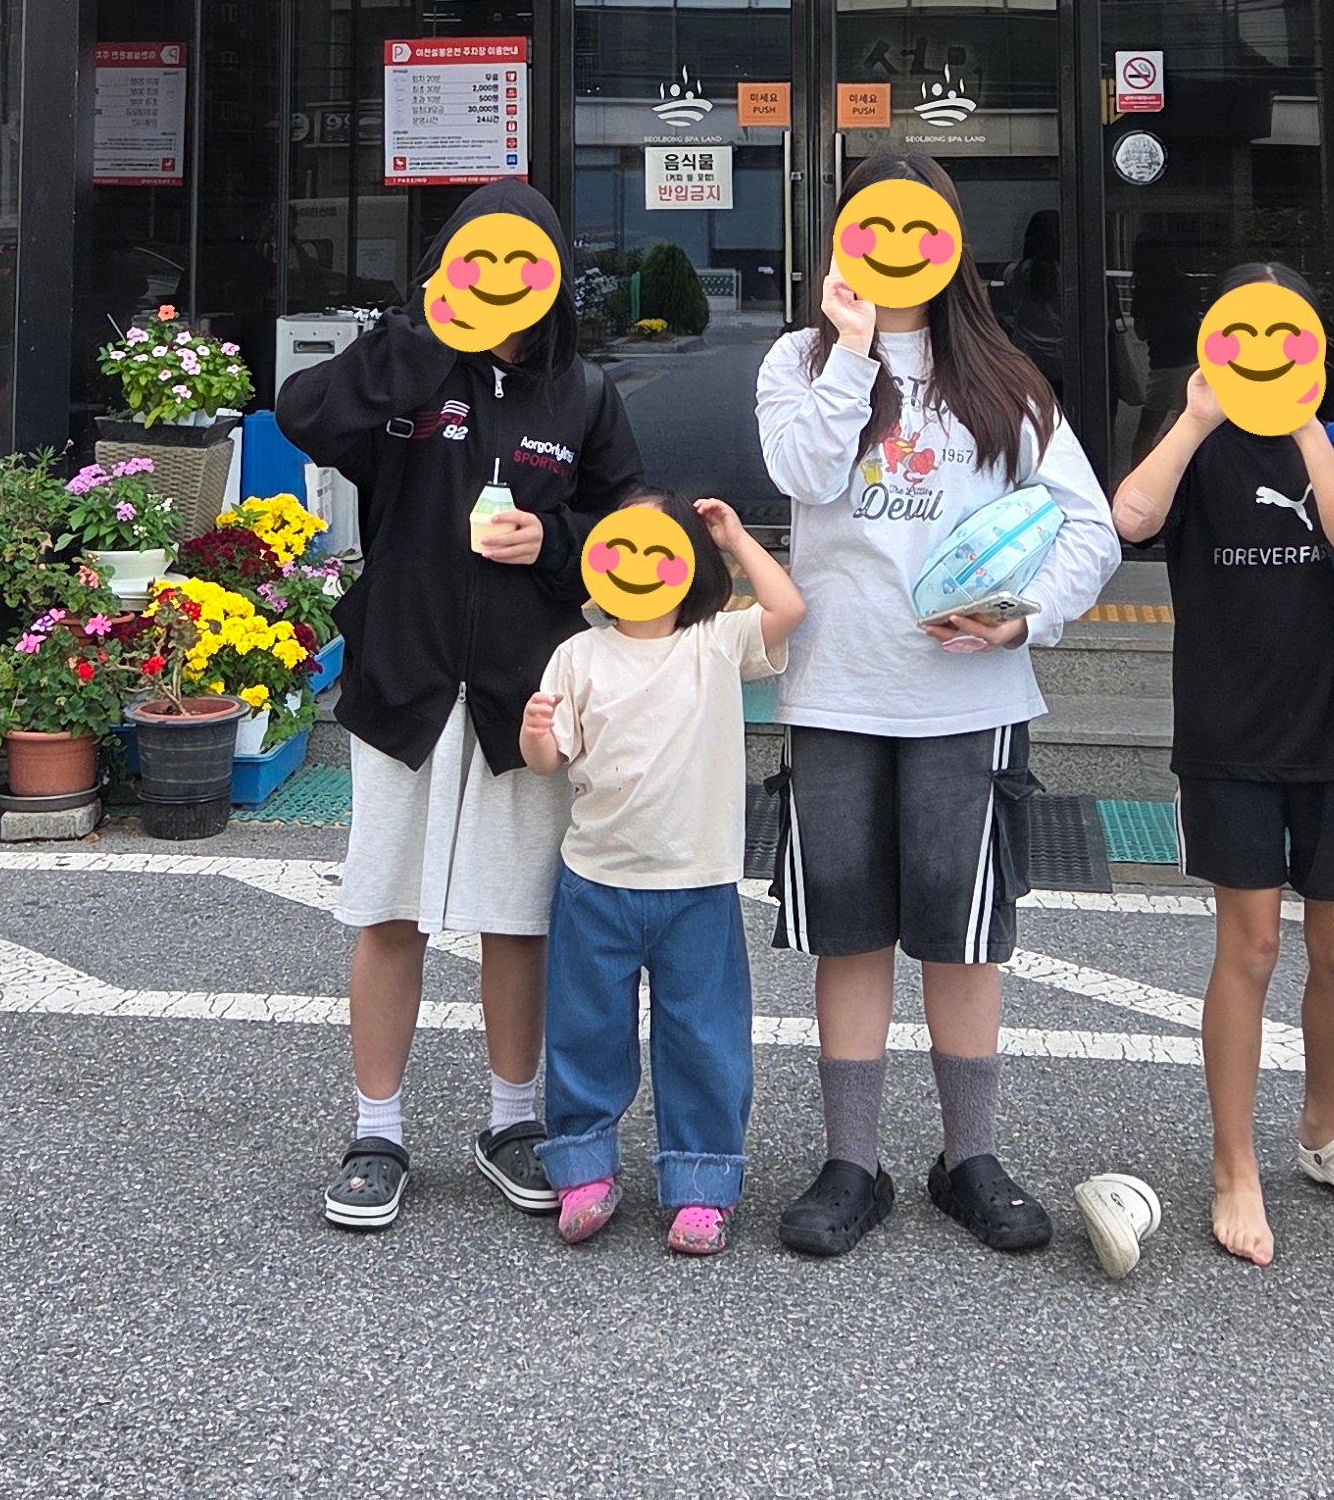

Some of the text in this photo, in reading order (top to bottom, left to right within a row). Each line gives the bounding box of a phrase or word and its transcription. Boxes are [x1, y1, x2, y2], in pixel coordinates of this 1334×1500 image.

[463, 46, 486, 57] 주차장
[487, 45, 519, 56] 이용안내
[750, 92, 778, 103] 미세요
[849, 93, 878, 104] 미세요
[753, 106, 776, 114] PUSH
[852, 107, 876, 115] PUSH
[700, 135, 723, 143] LAND
[964, 135, 987, 143] LAND
[663, 153, 714, 171] 음식물
[658, 184, 721, 202] 반입금지
